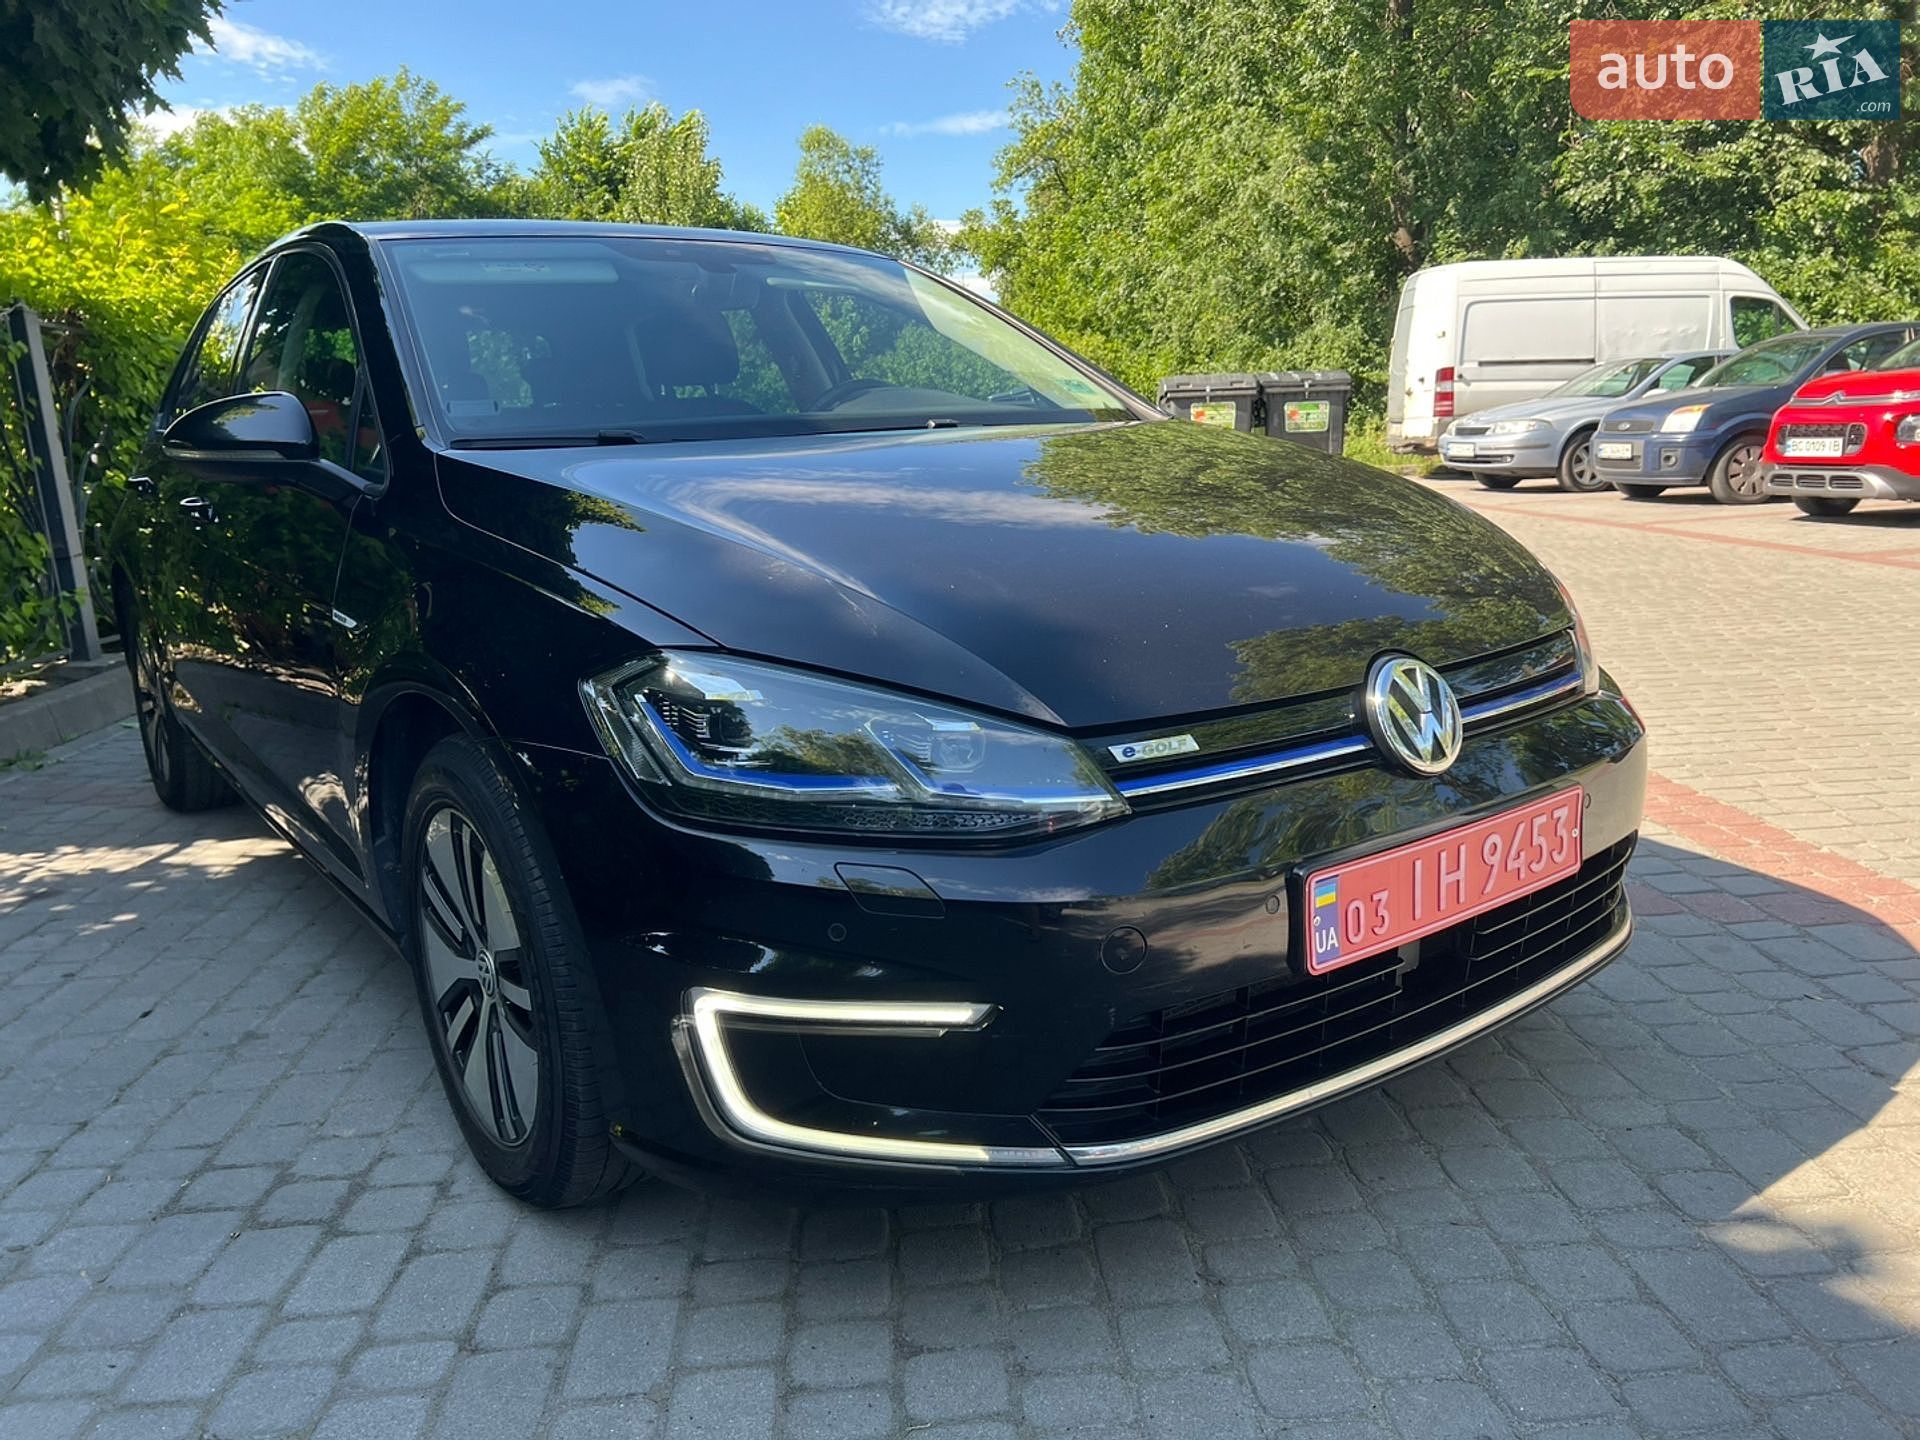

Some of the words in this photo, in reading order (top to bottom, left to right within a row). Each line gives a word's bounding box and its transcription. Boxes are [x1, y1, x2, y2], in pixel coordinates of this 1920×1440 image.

[1345, 889, 1390, 945] 03
[1412, 842, 1467, 921] IH
[1481, 805, 1570, 896] 9453
[1315, 925, 1338, 954] UA
